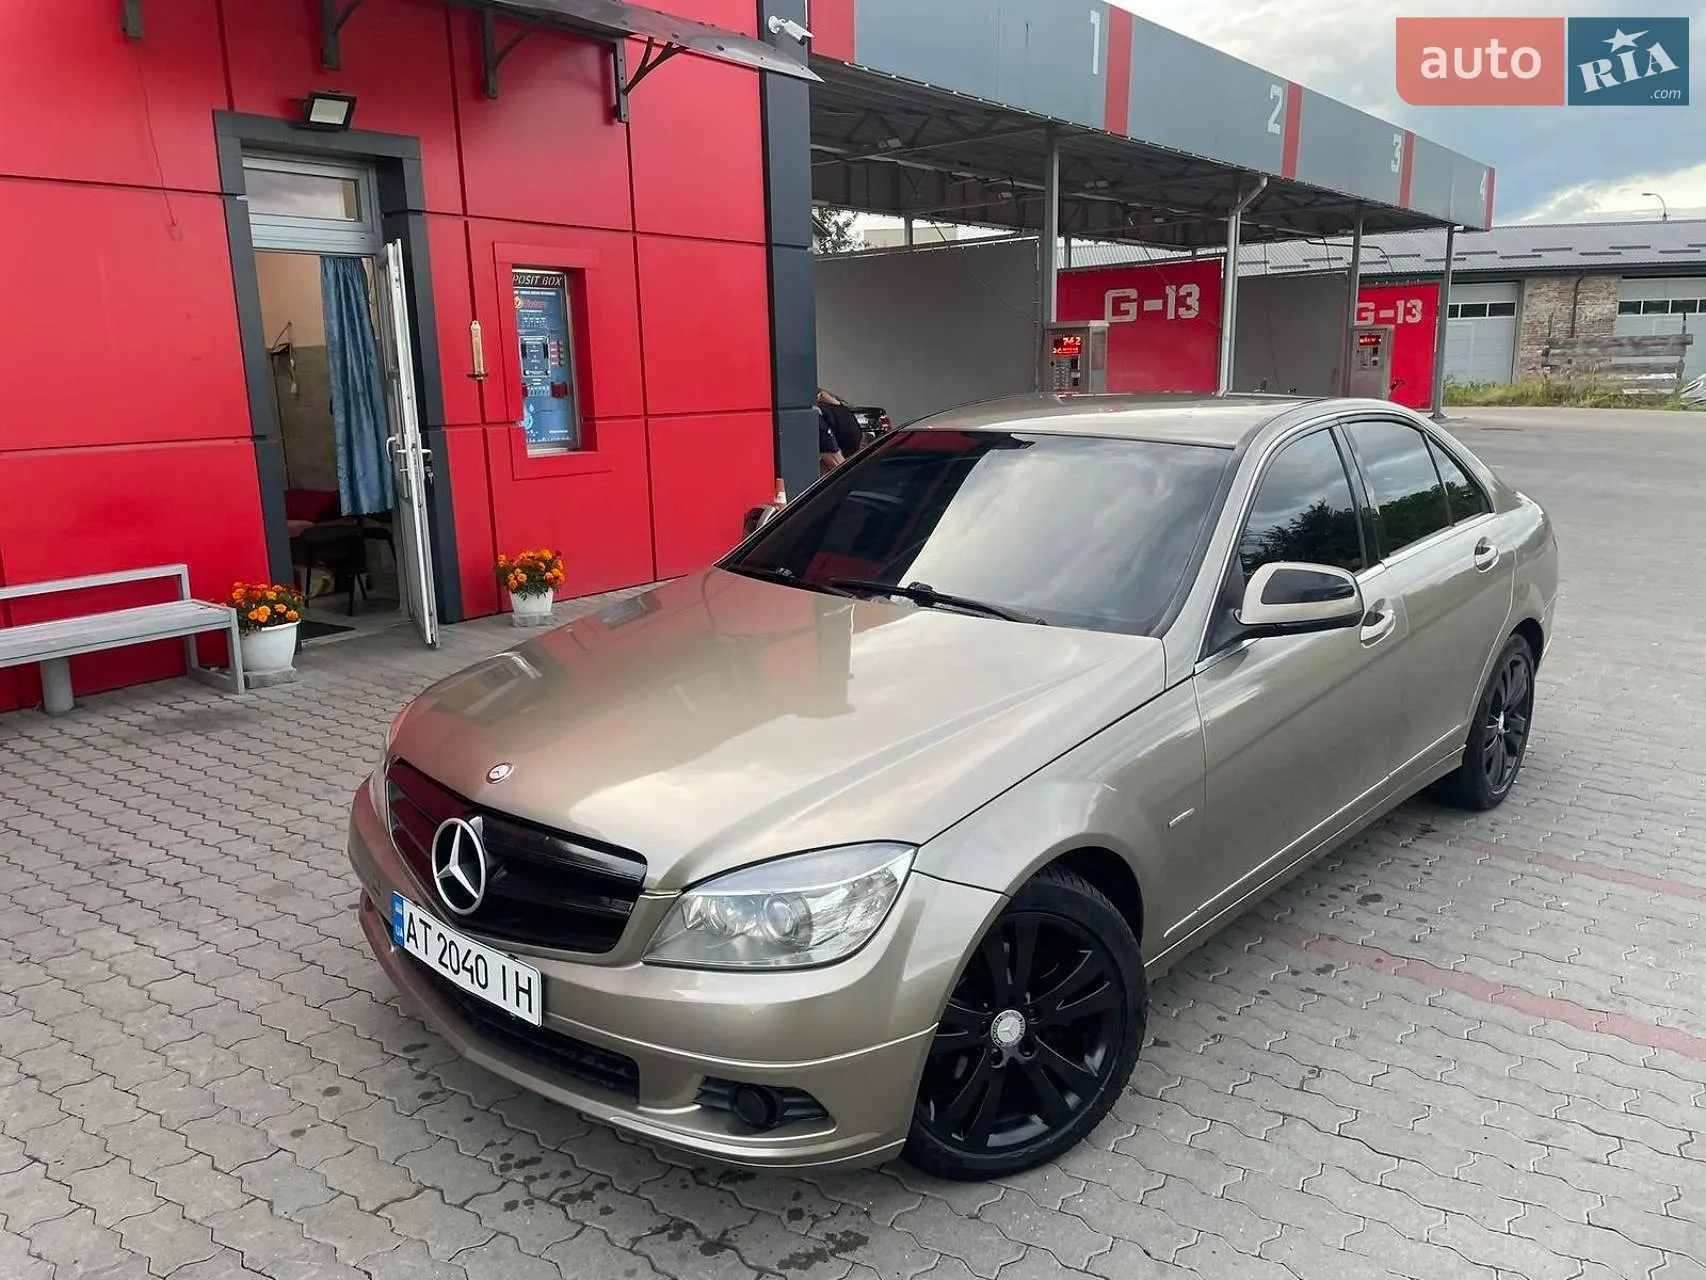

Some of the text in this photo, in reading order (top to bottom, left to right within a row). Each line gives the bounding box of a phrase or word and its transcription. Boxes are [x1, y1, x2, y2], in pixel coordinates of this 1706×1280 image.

[1089, 10, 1100, 76] 1
[1267, 84, 1285, 135] 2
[1390, 134, 1402, 173] 3
[542, 276, 563, 286] BOX
[1104, 283, 1201, 323] G-13
[1354, 299, 1423, 326] G-13
[406, 911, 533, 1014] AT 2040 IH
